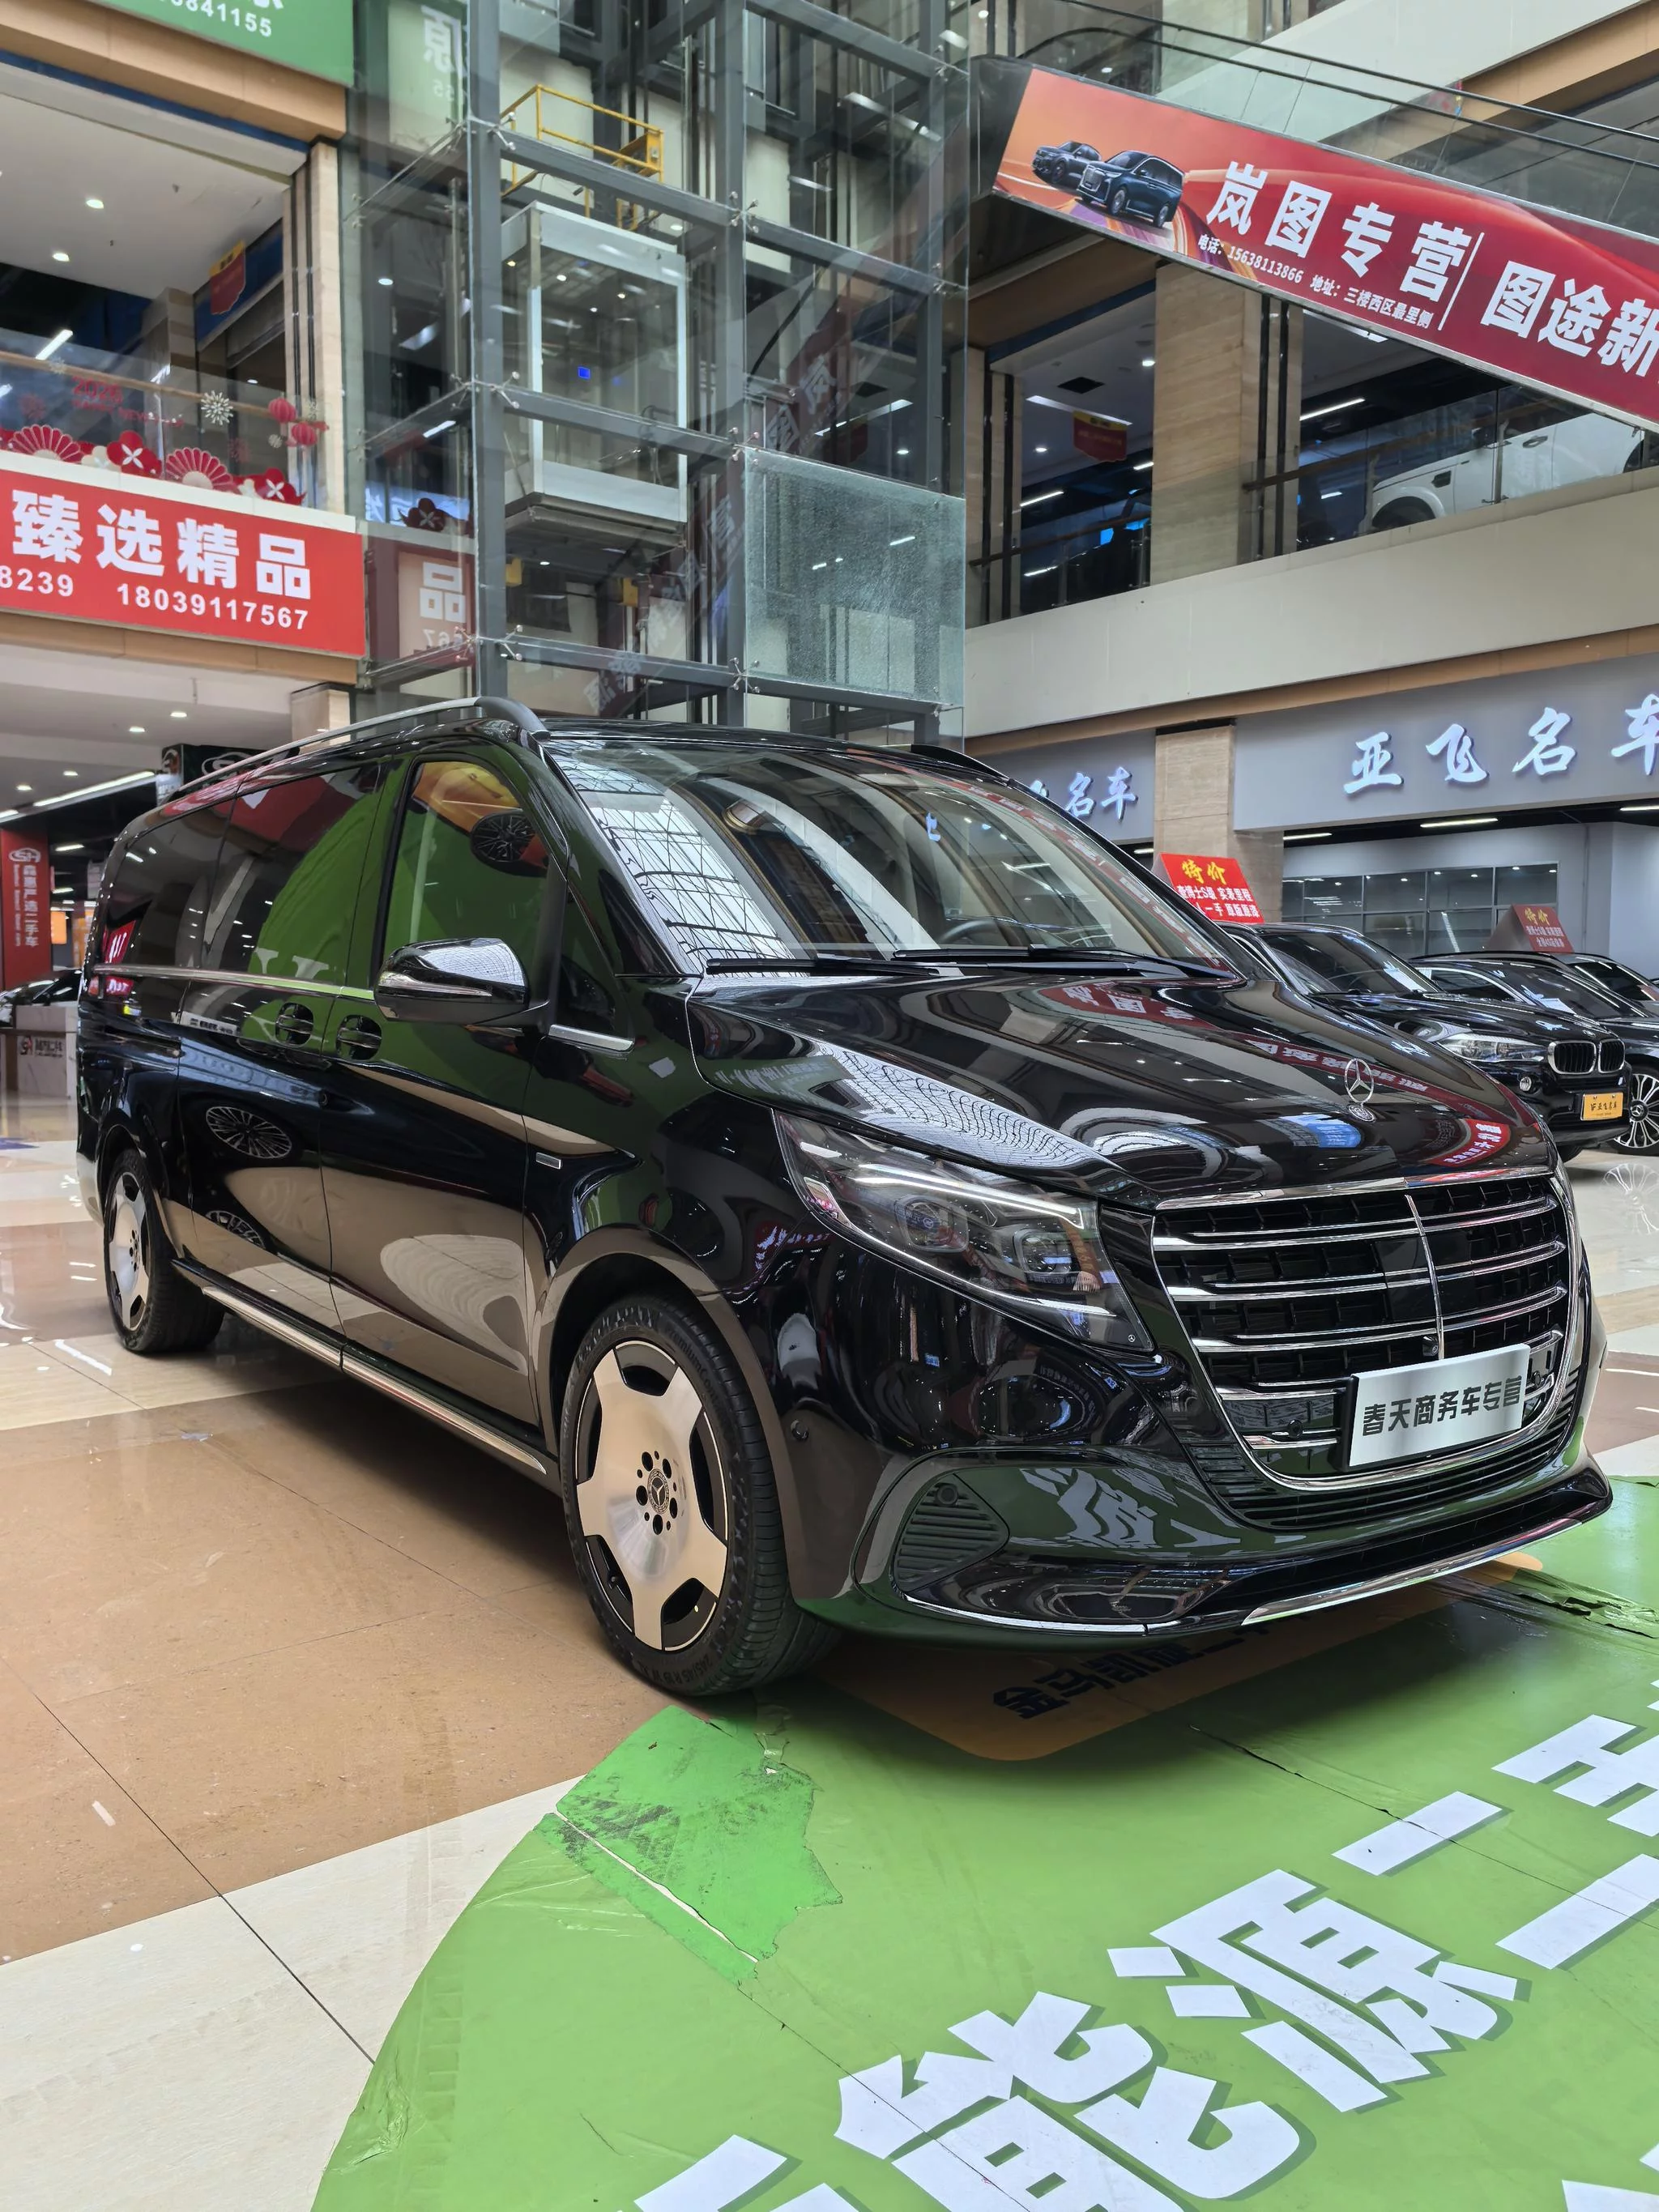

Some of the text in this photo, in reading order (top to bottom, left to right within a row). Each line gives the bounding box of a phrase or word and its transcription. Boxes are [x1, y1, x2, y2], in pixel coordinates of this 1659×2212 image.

[1206, 160, 1659, 377] 岚图专营 图途新
[12, 489, 311, 599] 臻选精品
[117, 583, 309, 630] 18039117567
[1343, 693, 1659, 795] 亚飞名车
[1030, 766, 1137, 820] 名车
[1181, 859, 1227, 884] 特价
[1362, 1375, 1523, 1437] 春天商务车专营
